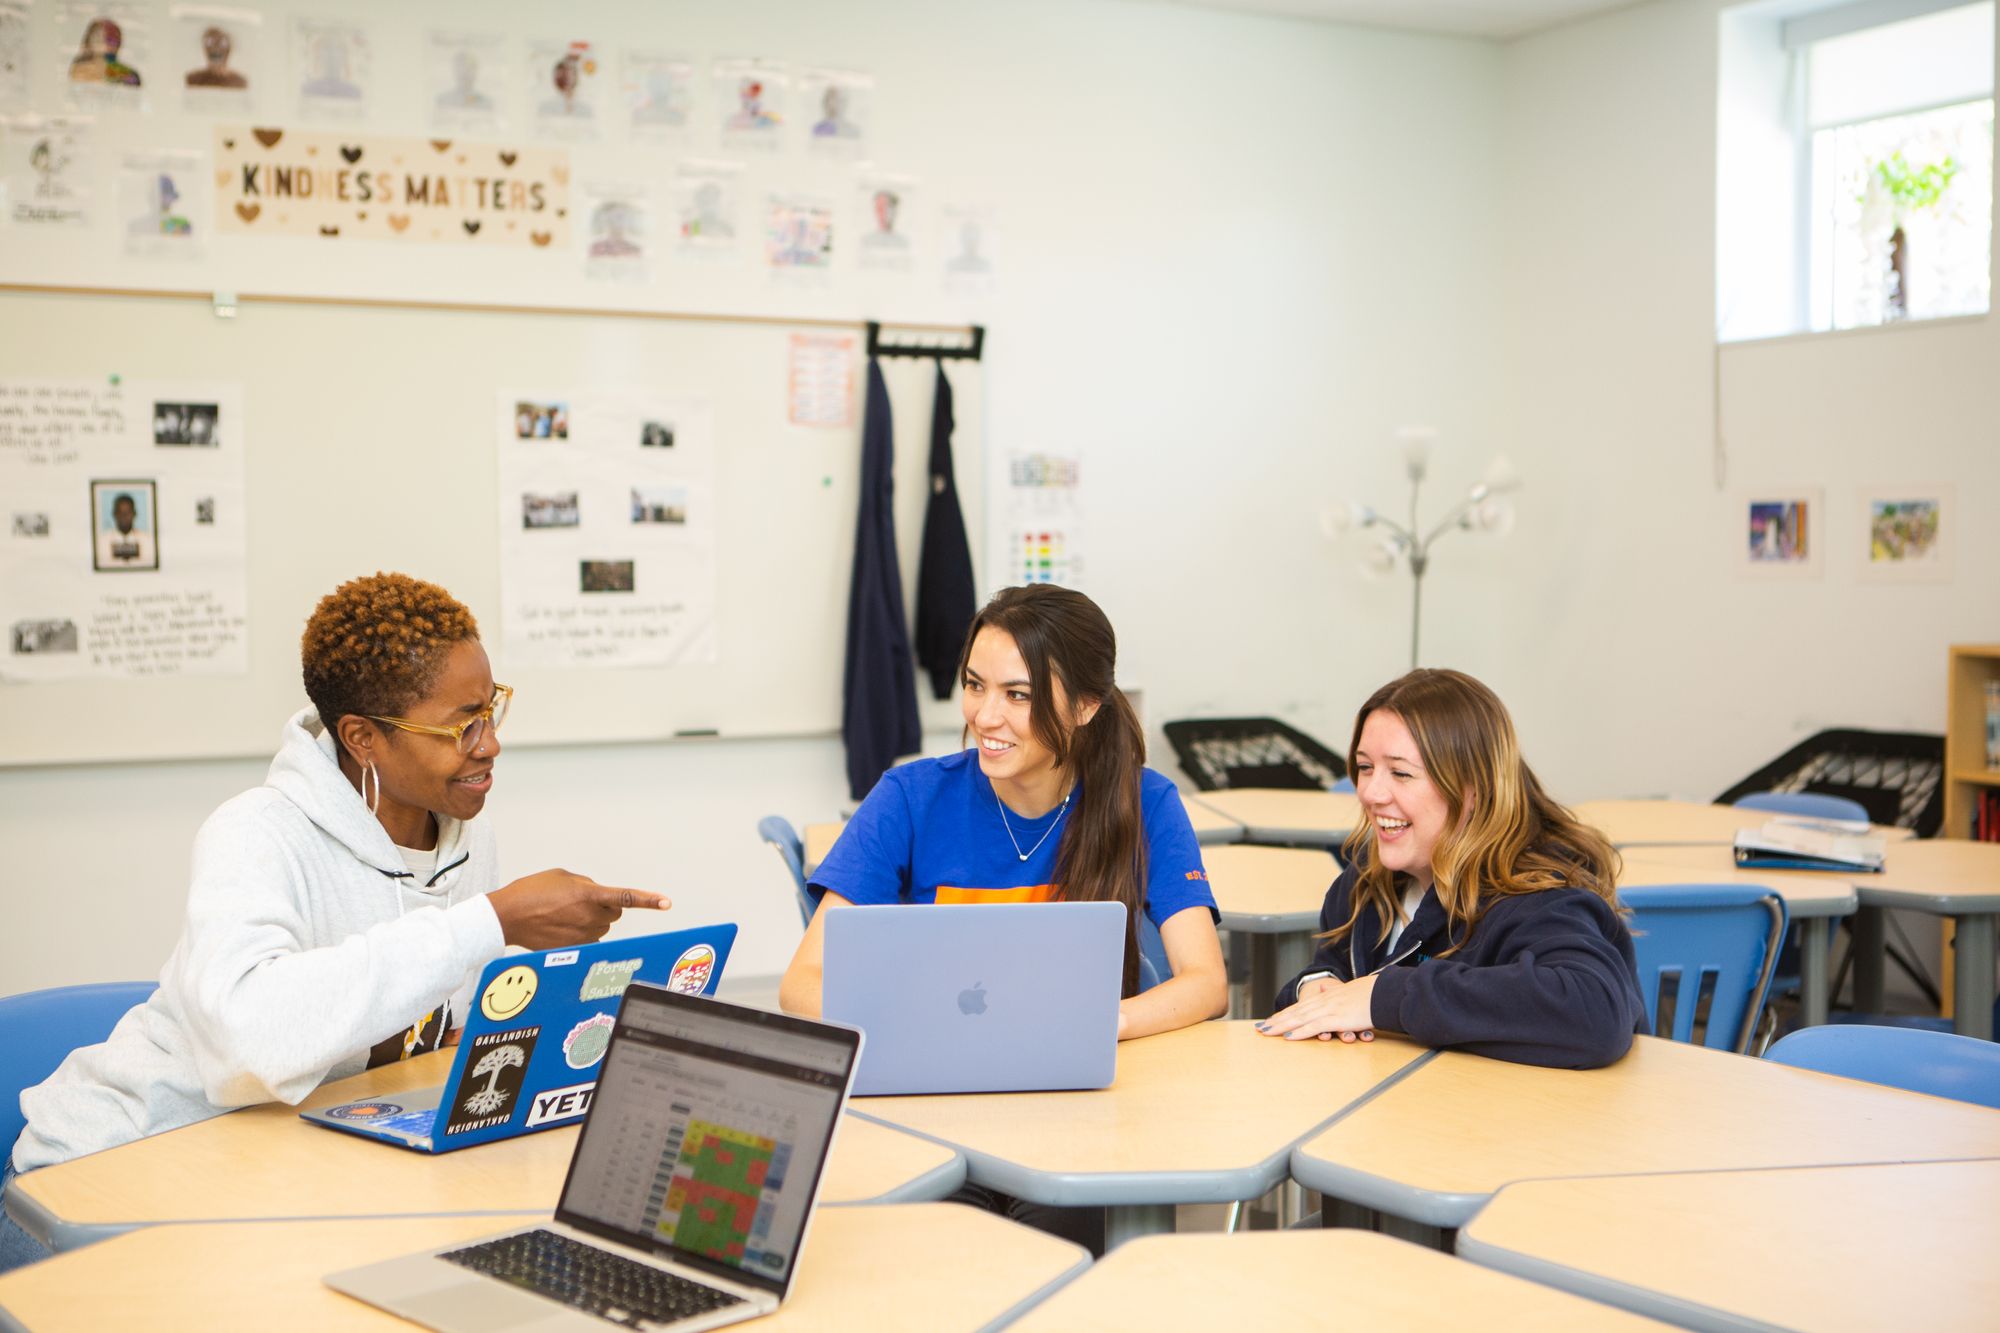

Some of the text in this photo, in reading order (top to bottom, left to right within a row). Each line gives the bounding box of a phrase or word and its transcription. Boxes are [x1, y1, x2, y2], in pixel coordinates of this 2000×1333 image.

[242, 163, 546, 211] KINDNESS MATTERS
[595, 959, 643, 975] Forage
[587, 984, 626, 998] Salva
[475, 1027, 540, 1047] OAKLANDISH
[539, 1089, 596, 1119] YET
[447, 1114, 512, 1135] OAKLANDISH
